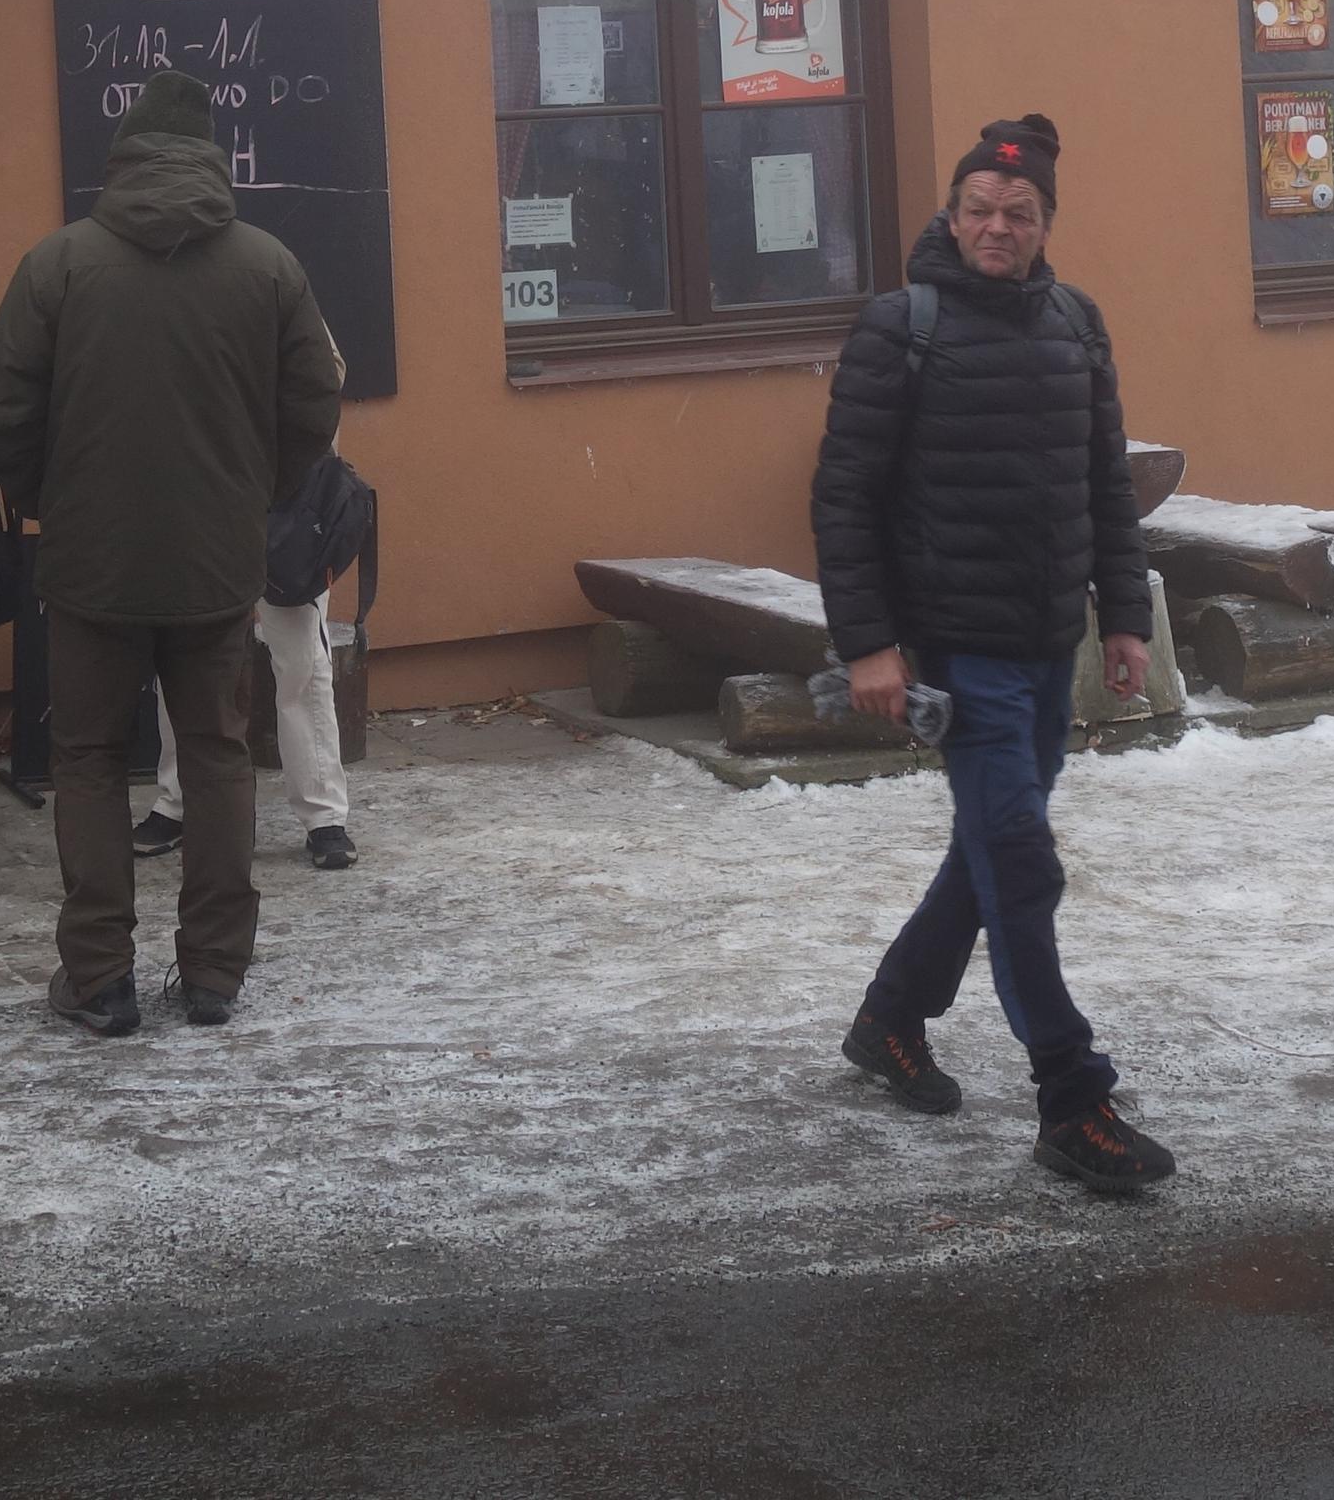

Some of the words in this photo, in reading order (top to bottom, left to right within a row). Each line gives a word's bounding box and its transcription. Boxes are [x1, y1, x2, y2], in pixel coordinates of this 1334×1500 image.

[762, 2, 794, 19] kofola
[808, 66, 830, 79] kofola
[270, 75, 330, 105] DO
[1264, 99, 1326, 117] POLOTMAVÝ
[505, 281, 554, 308] 103
